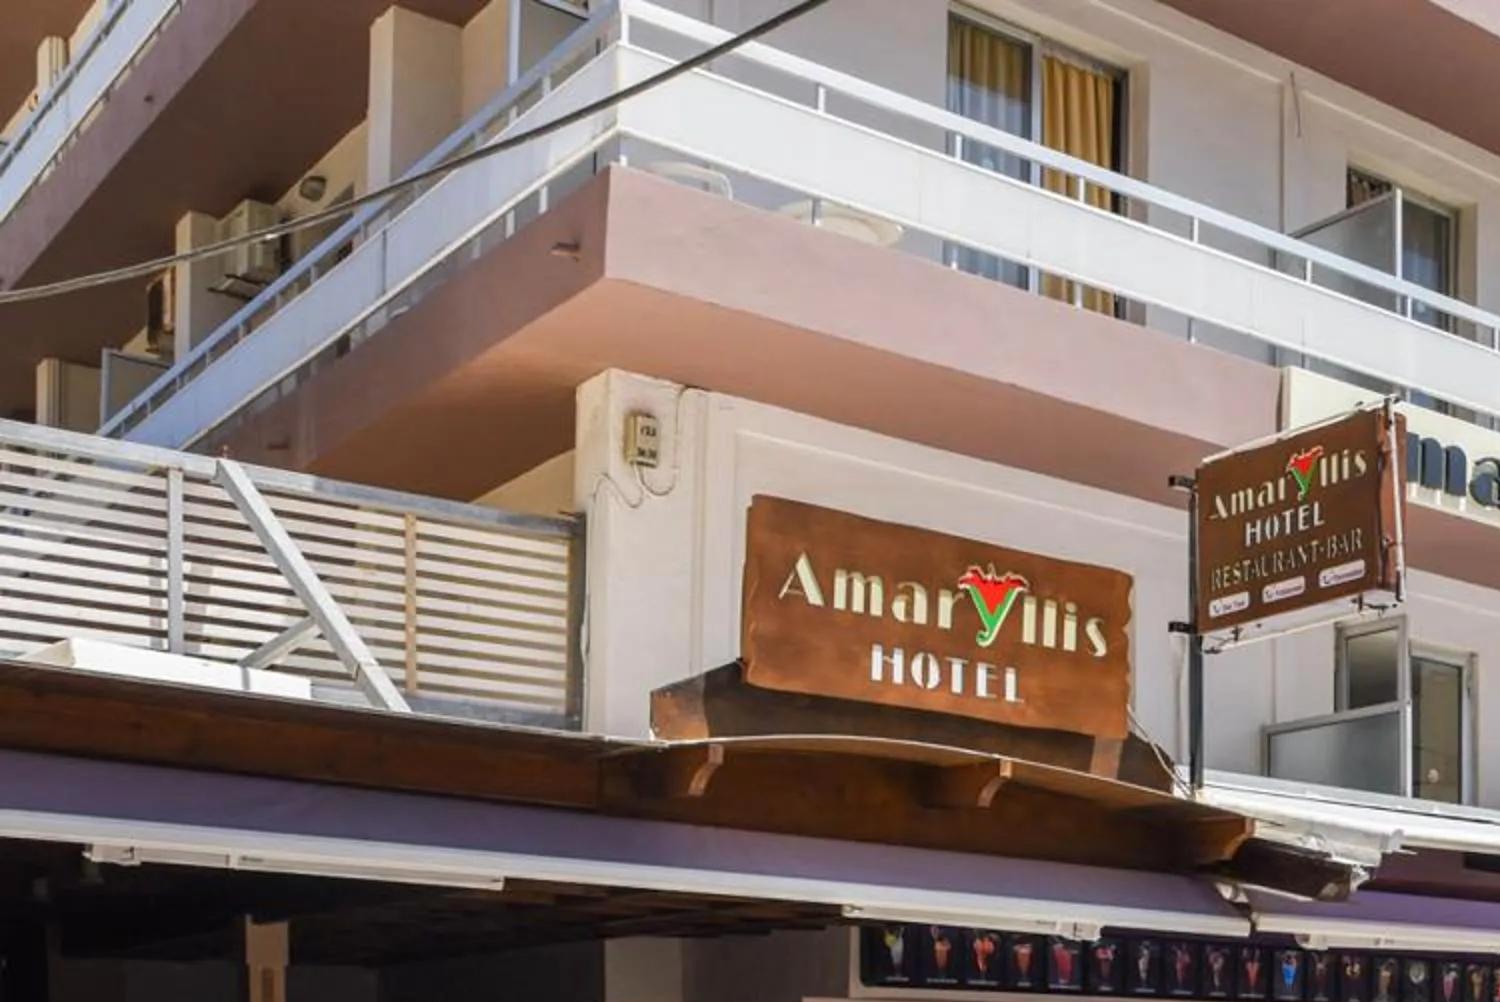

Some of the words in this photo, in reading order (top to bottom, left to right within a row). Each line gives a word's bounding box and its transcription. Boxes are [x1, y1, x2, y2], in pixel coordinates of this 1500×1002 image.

[1209, 445, 1368, 520] Amaryllis
[1244, 501, 1325, 547] HOTEL
[778, 551, 1108, 658] Amaryllis
[870, 643, 1025, 703] HOTEL
